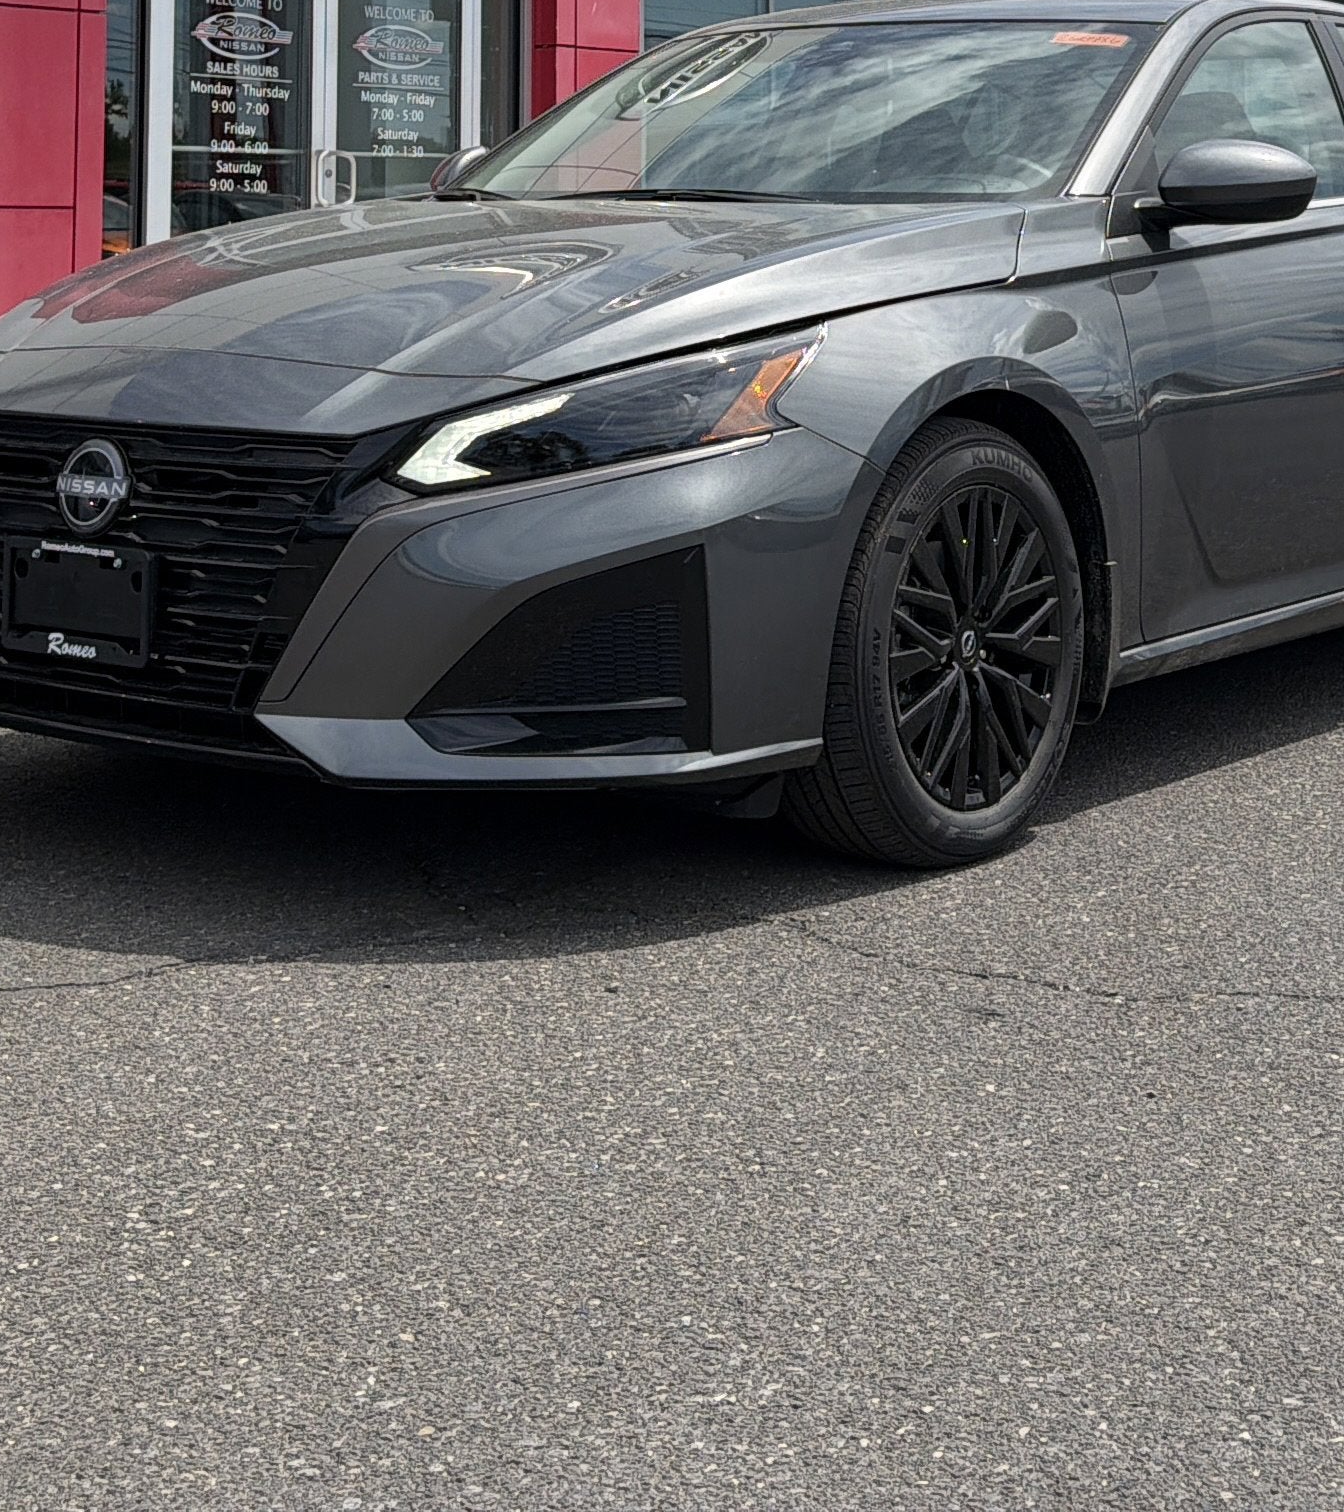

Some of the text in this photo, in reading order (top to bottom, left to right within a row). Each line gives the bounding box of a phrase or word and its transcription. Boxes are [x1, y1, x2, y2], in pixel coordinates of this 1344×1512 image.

[364, 5, 434, 23] WELCOME TO
[213, 15, 276, 40] Romeo
[219, 40, 265, 52] NISSAN
[374, 29, 430, 51] Romeo
[378, 52, 420, 62] NISSAN
[206, 61, 279, 77] SALES HOURS
[358, 71, 440, 86] PARTS & SERVICE
[190, 81, 233, 98] Monday
[242, 84, 290, 101] Thursday
[361, 90, 399, 105] Monday
[406, 92, 435, 108] Friday
[211, 100, 236, 114] 9:00
[245, 102, 270, 116] 7:00
[372, 108, 394, 121] 7:00
[402, 109, 424, 122] 5:00
[224, 122, 256, 137] Friday
[377, 127, 418, 142] Saturday
[210, 139, 235, 152] 9:00
[244, 141, 269, 154] 6:00
[216, 160, 262, 177] Saturday
[209, 178, 234, 192] 9:00
[244, 180, 268, 193] 5:00
[971, 447, 1033, 483] KUMHO
[57, 474, 127, 496] NISSAN
[47, 632, 96, 659] Romeo
